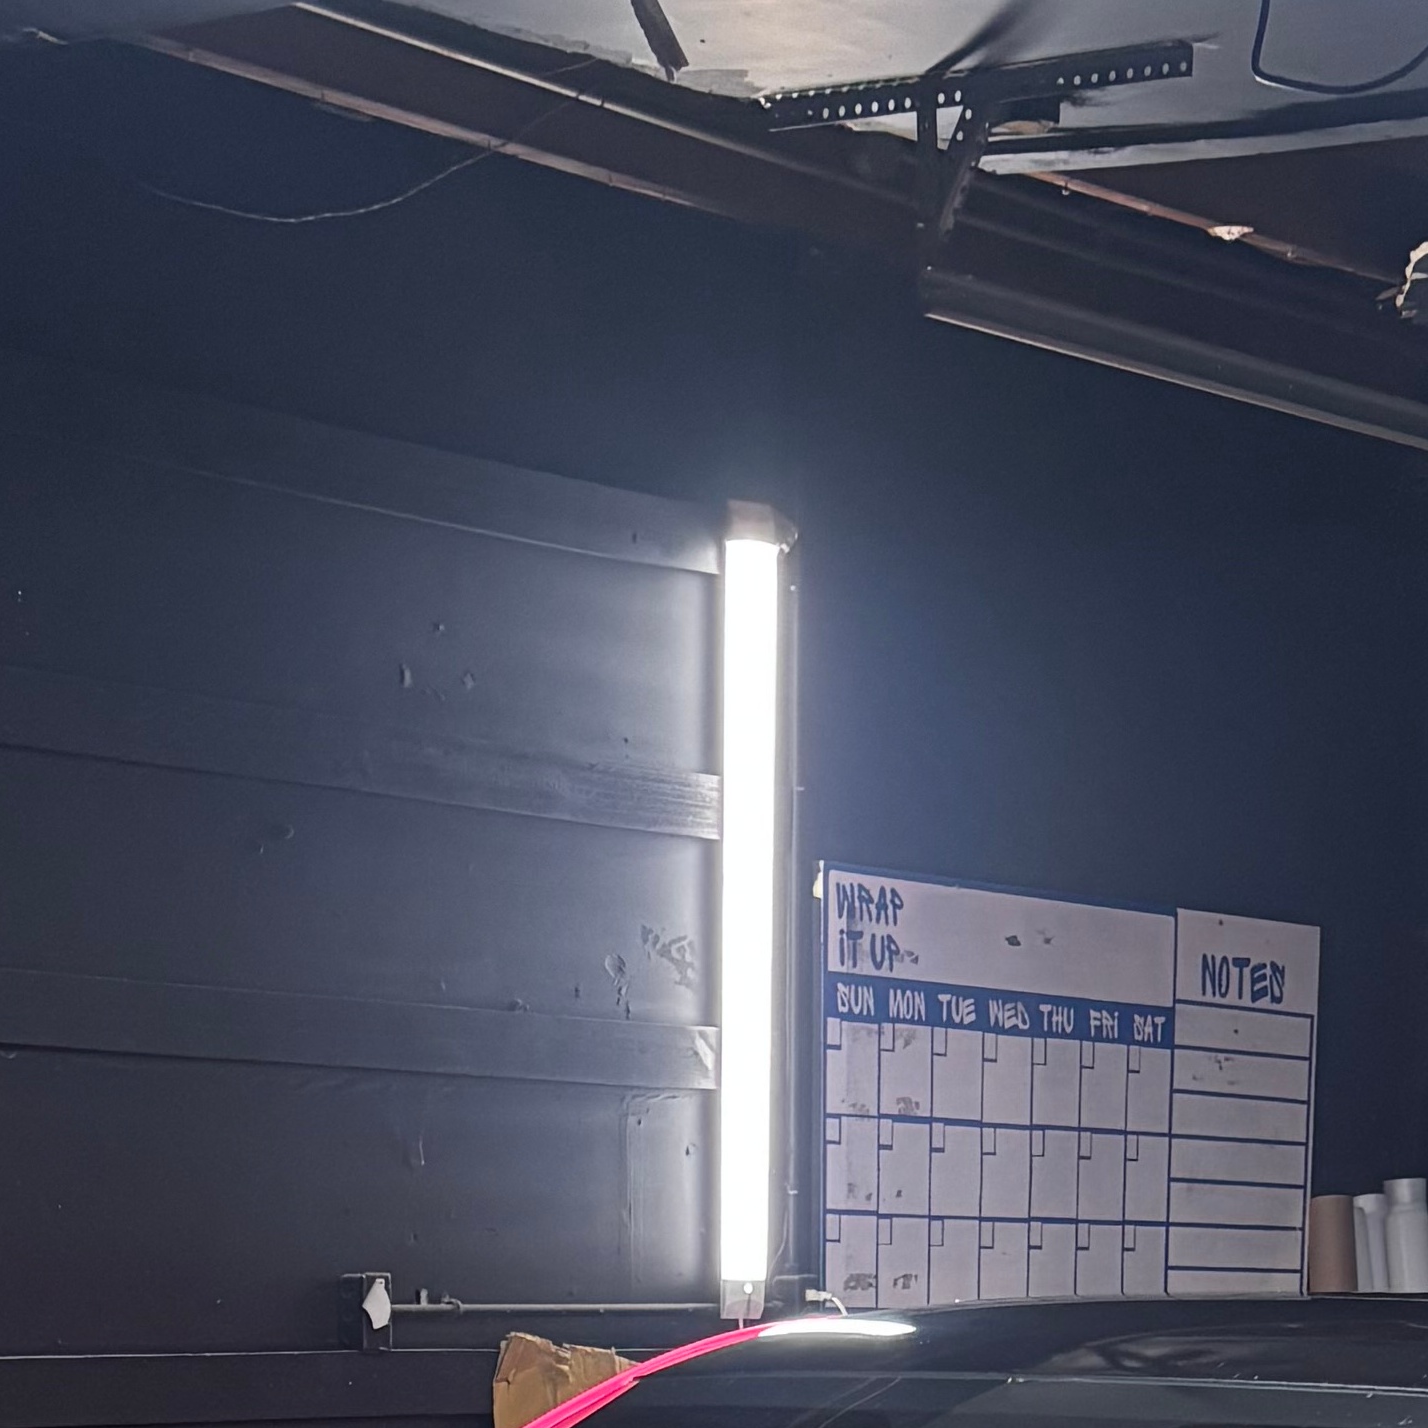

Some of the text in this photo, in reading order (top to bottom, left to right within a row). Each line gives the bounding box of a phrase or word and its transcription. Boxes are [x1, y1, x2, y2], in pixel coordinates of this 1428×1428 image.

[836, 882, 904, 926] WRAP
[870, 932, 900, 973] UP
[1200, 952, 1285, 1005] NOTES
[837, 982, 875, 1016] SUN
[889, 988, 927, 1022] MON
[937, 993, 976, 1025] TUE
[988, 998, 1030, 1030] WED
[1039, 1003, 1075, 1034] THU
[1133, 1013, 1167, 1043] SAT
